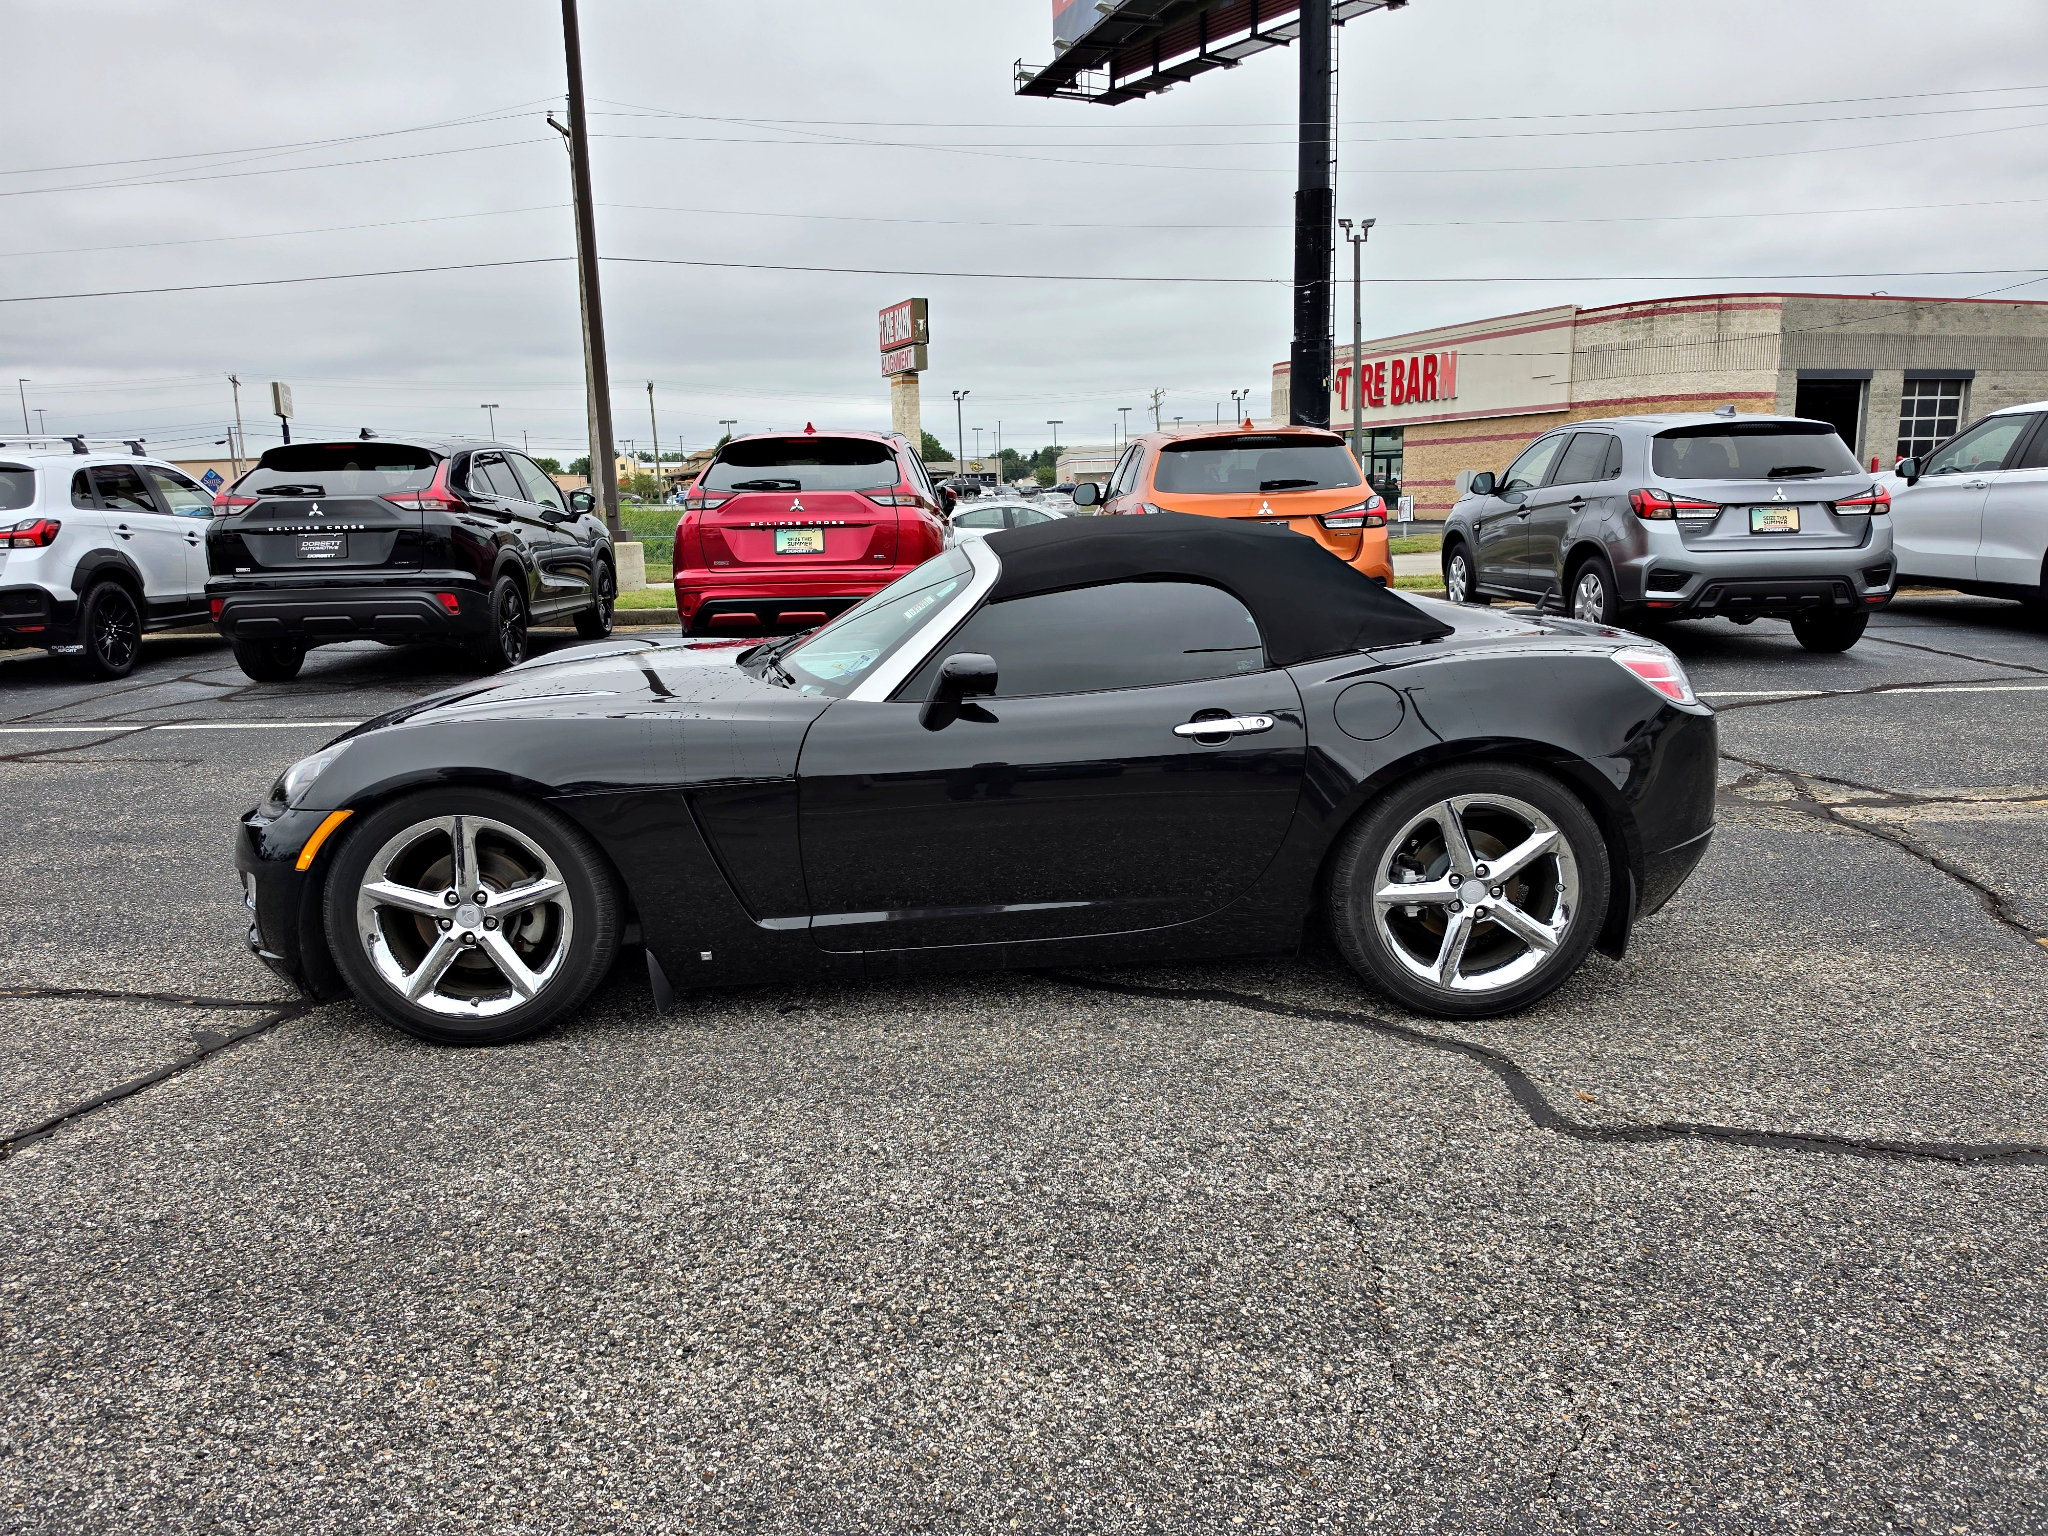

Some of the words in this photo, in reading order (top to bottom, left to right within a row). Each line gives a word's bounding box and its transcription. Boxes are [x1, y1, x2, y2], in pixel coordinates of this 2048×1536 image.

[895, 304, 911, 342] BARN
[881, 349, 912, 375] ALIGNMENT
[1335, 361, 1386, 411] TRE
[1391, 350, 1458, 405] BARN
